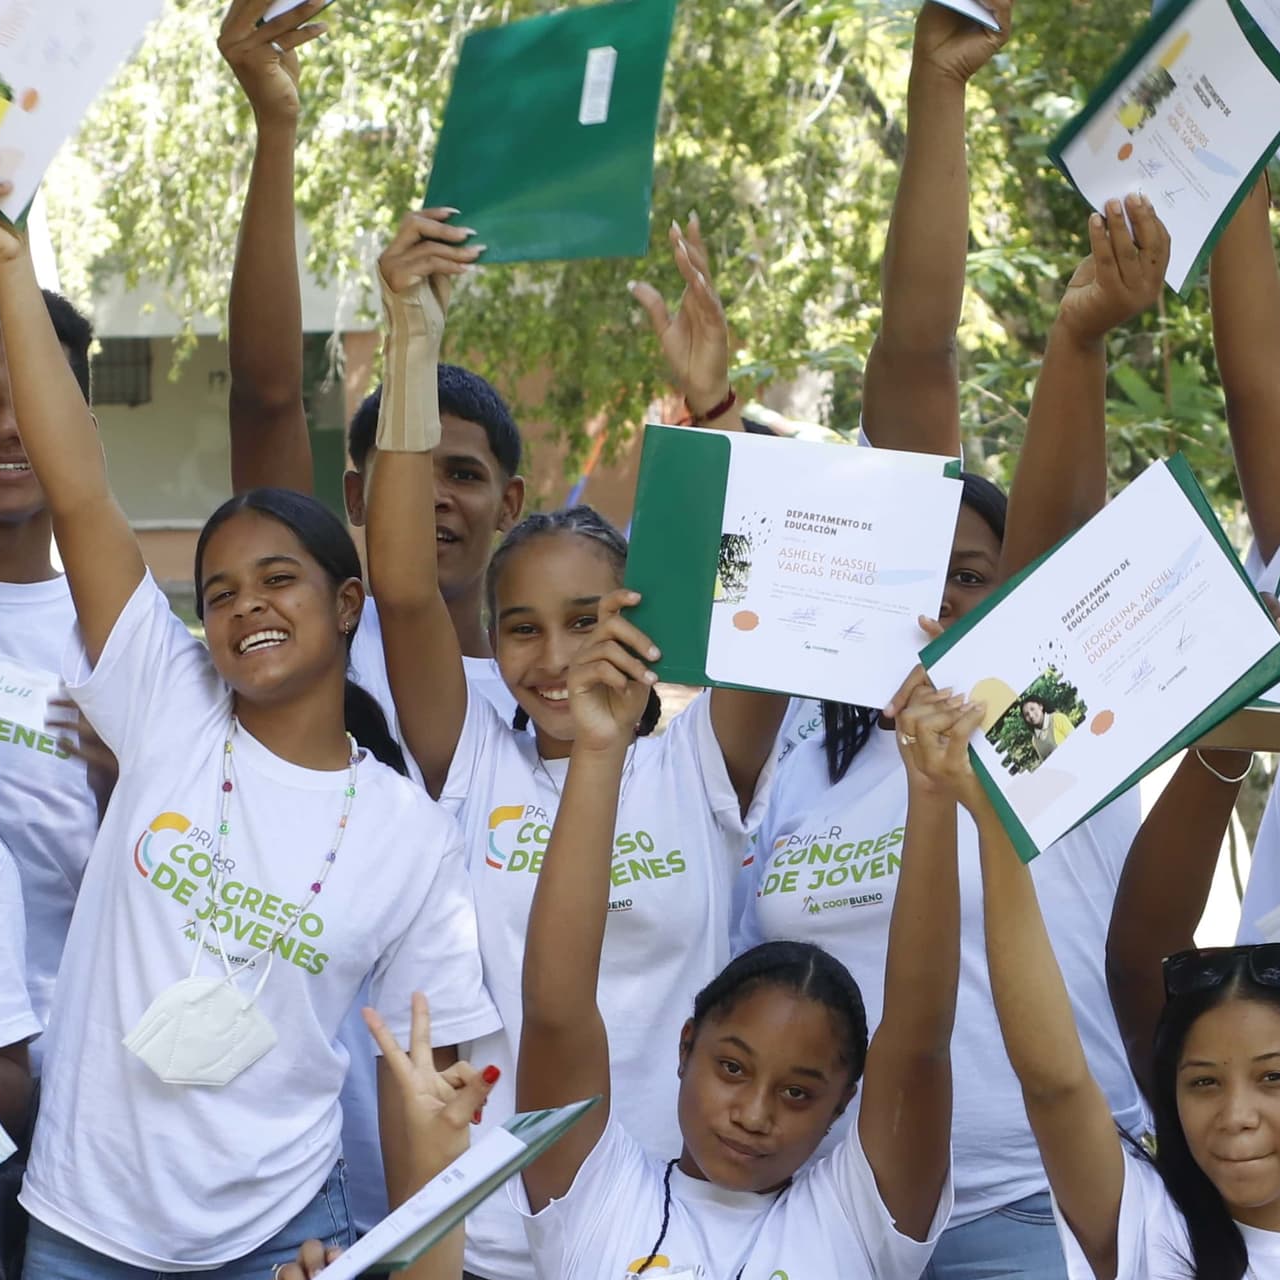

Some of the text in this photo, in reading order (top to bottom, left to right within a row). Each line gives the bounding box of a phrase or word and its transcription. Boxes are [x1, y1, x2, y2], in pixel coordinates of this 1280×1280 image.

[784, 520, 837, 536] EDUCACIÓN
[786, 509, 872, 531] DEPARTAMENTO DE
[776, 561, 824, 577] VARGAS
[778, 547, 878, 573] ASHELEY MASSIEL
[1061, 568, 1120, 624] DEPARTAMENTO
[1120, 558, 1131, 571] DE
[1066, 591, 1110, 632] EDUCACIÓN
[773, 827, 905, 868] CONGRES
[151, 862, 199, 906] DE
[763, 852, 903, 896] DE JÓVEN
[822, 893, 883, 910] COOPBUENO
